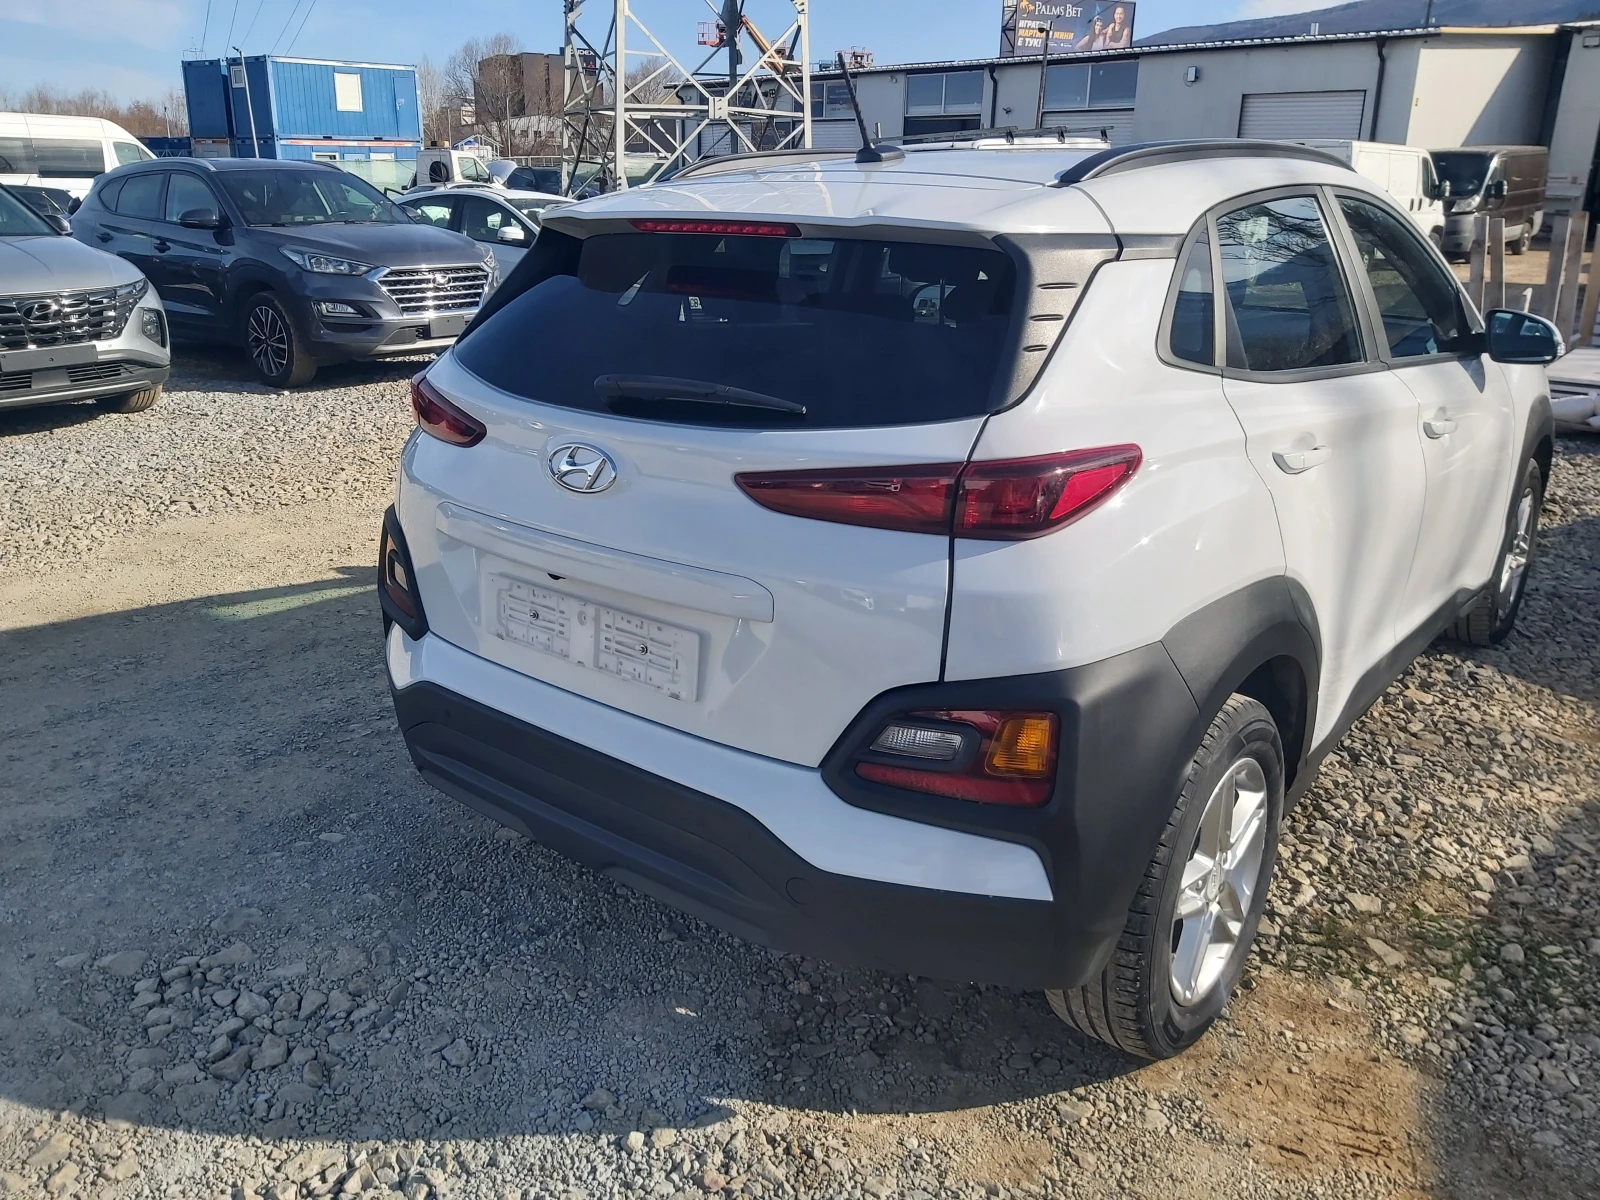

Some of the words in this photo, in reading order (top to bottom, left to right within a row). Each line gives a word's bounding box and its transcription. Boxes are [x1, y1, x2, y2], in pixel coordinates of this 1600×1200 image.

[1035, 1, 1065, 16] PALMS
[1065, 4, 1083, 18] BET
[1017, 38, 1024, 46] Е
